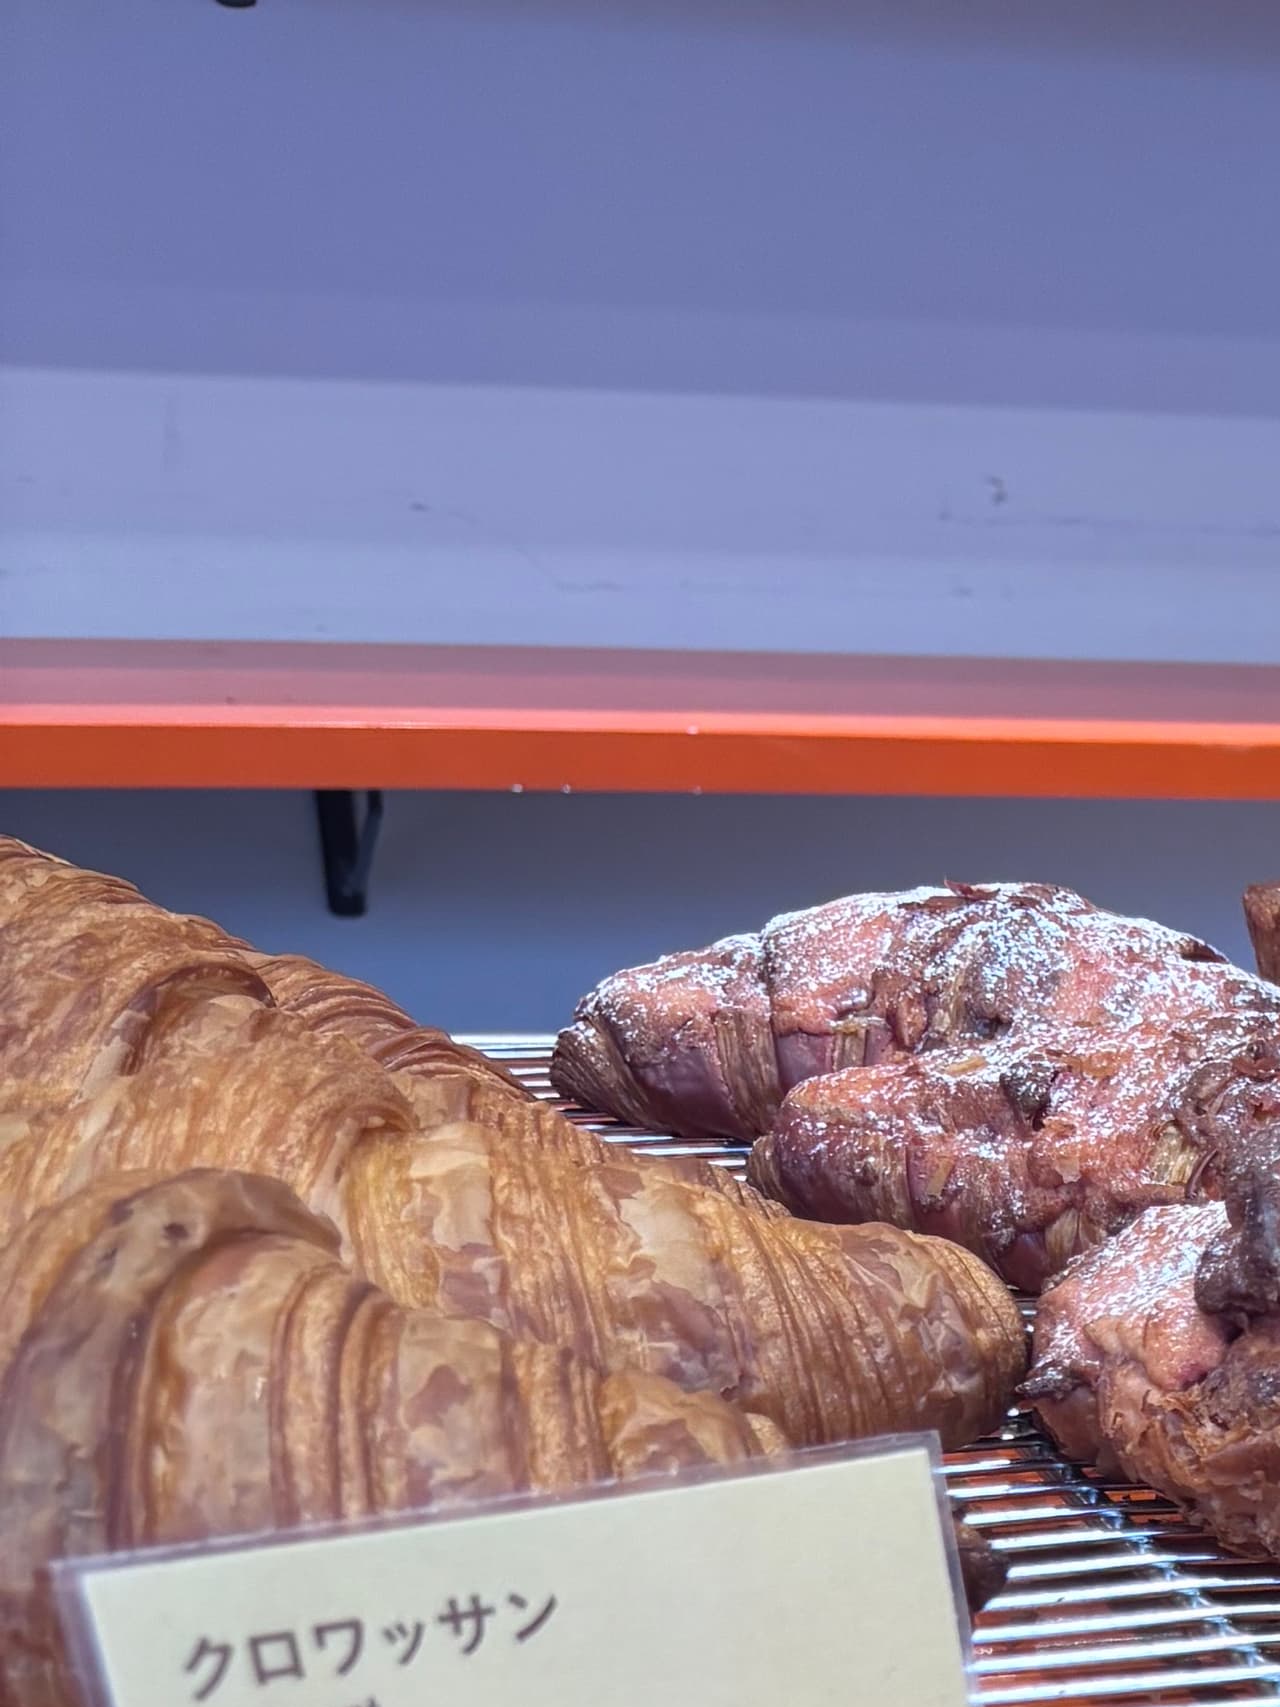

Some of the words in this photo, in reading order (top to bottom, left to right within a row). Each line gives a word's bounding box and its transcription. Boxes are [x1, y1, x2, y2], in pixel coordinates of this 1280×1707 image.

[183, 1588, 559, 1703] クロワッサン
